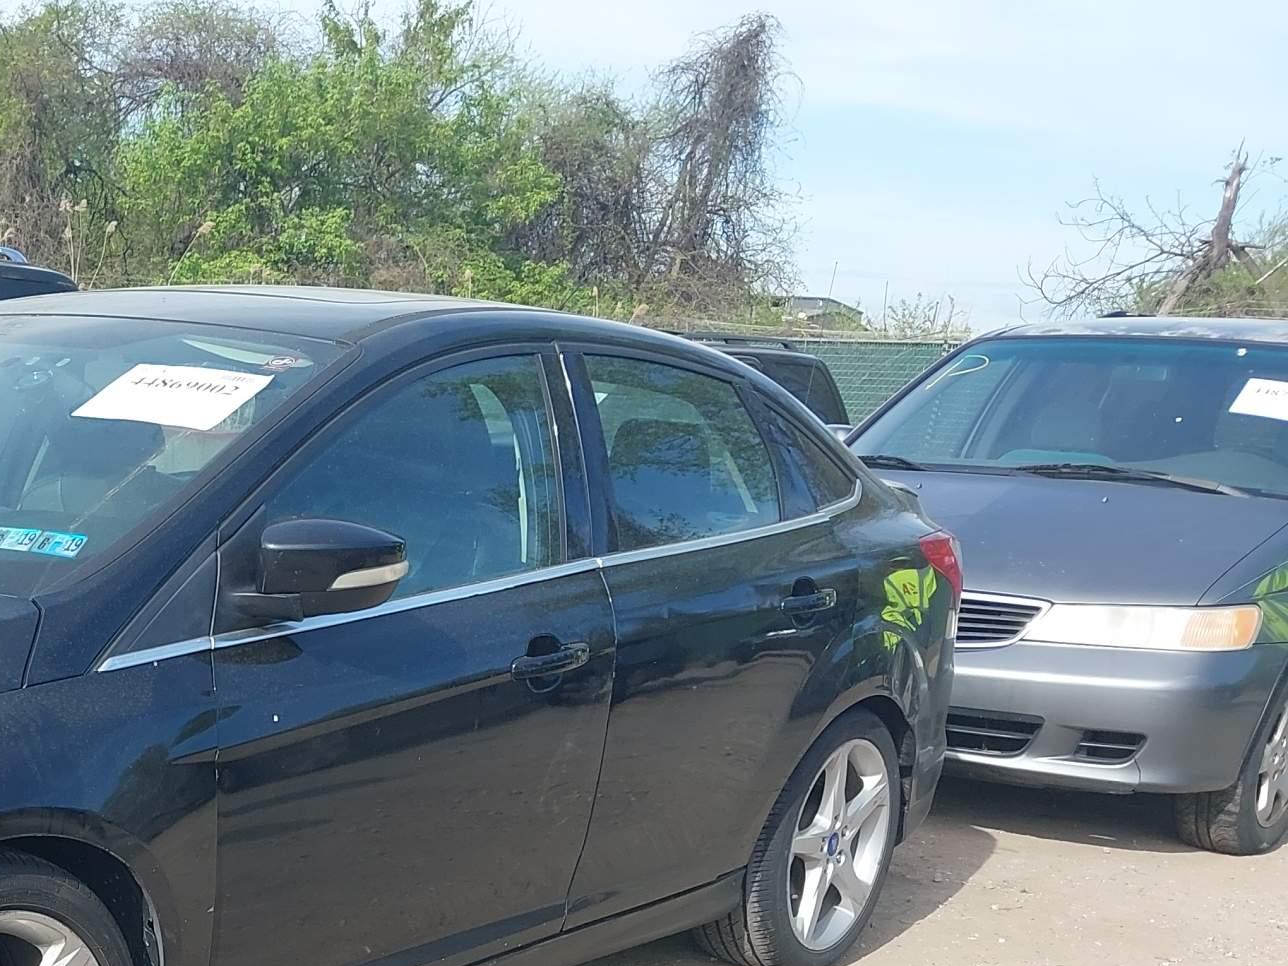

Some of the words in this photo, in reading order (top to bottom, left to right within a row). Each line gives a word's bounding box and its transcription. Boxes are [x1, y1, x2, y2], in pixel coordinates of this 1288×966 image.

[130, 376, 240, 396] 44869002
[16, 531, 38, 546] 19
[63, 537, 84, 552] 19
